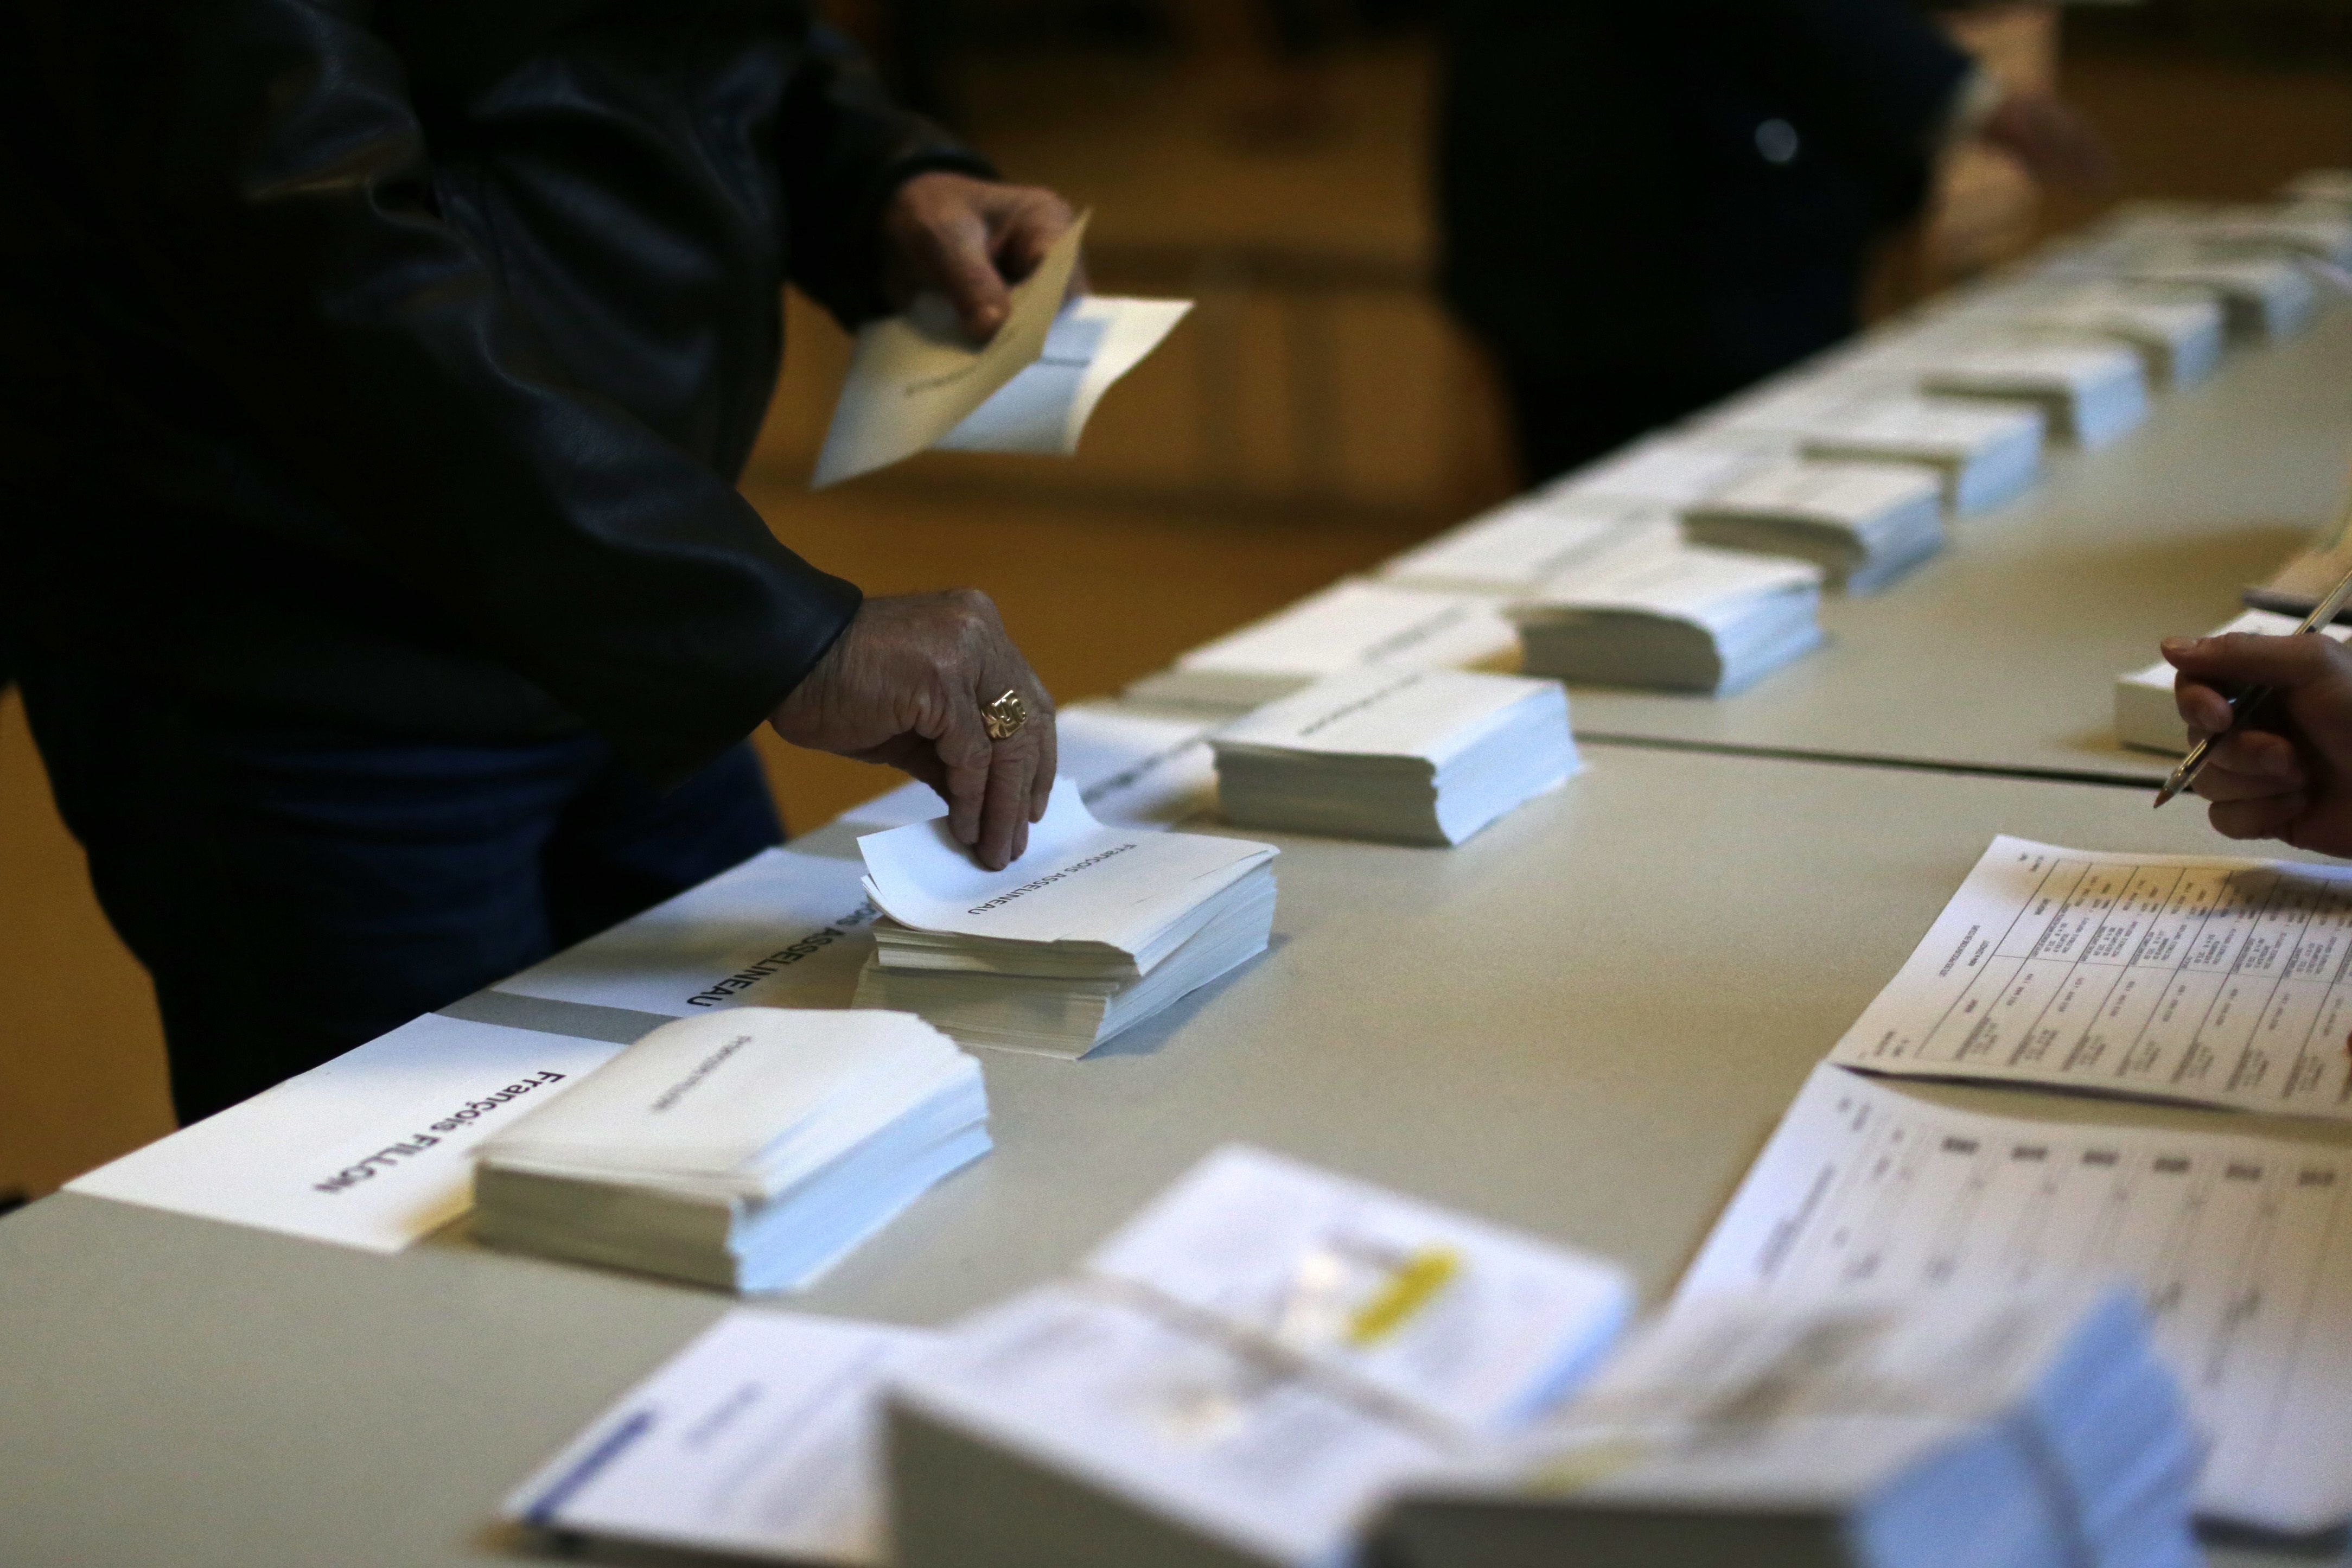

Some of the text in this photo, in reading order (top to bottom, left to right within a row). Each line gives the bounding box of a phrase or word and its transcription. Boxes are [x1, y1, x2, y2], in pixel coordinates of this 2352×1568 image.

[967, 872, 1066, 915] ASSELINEAU
[686, 927, 845, 1007] ASSELINEAU
[313, 1070, 567, 1193] François FILLON
